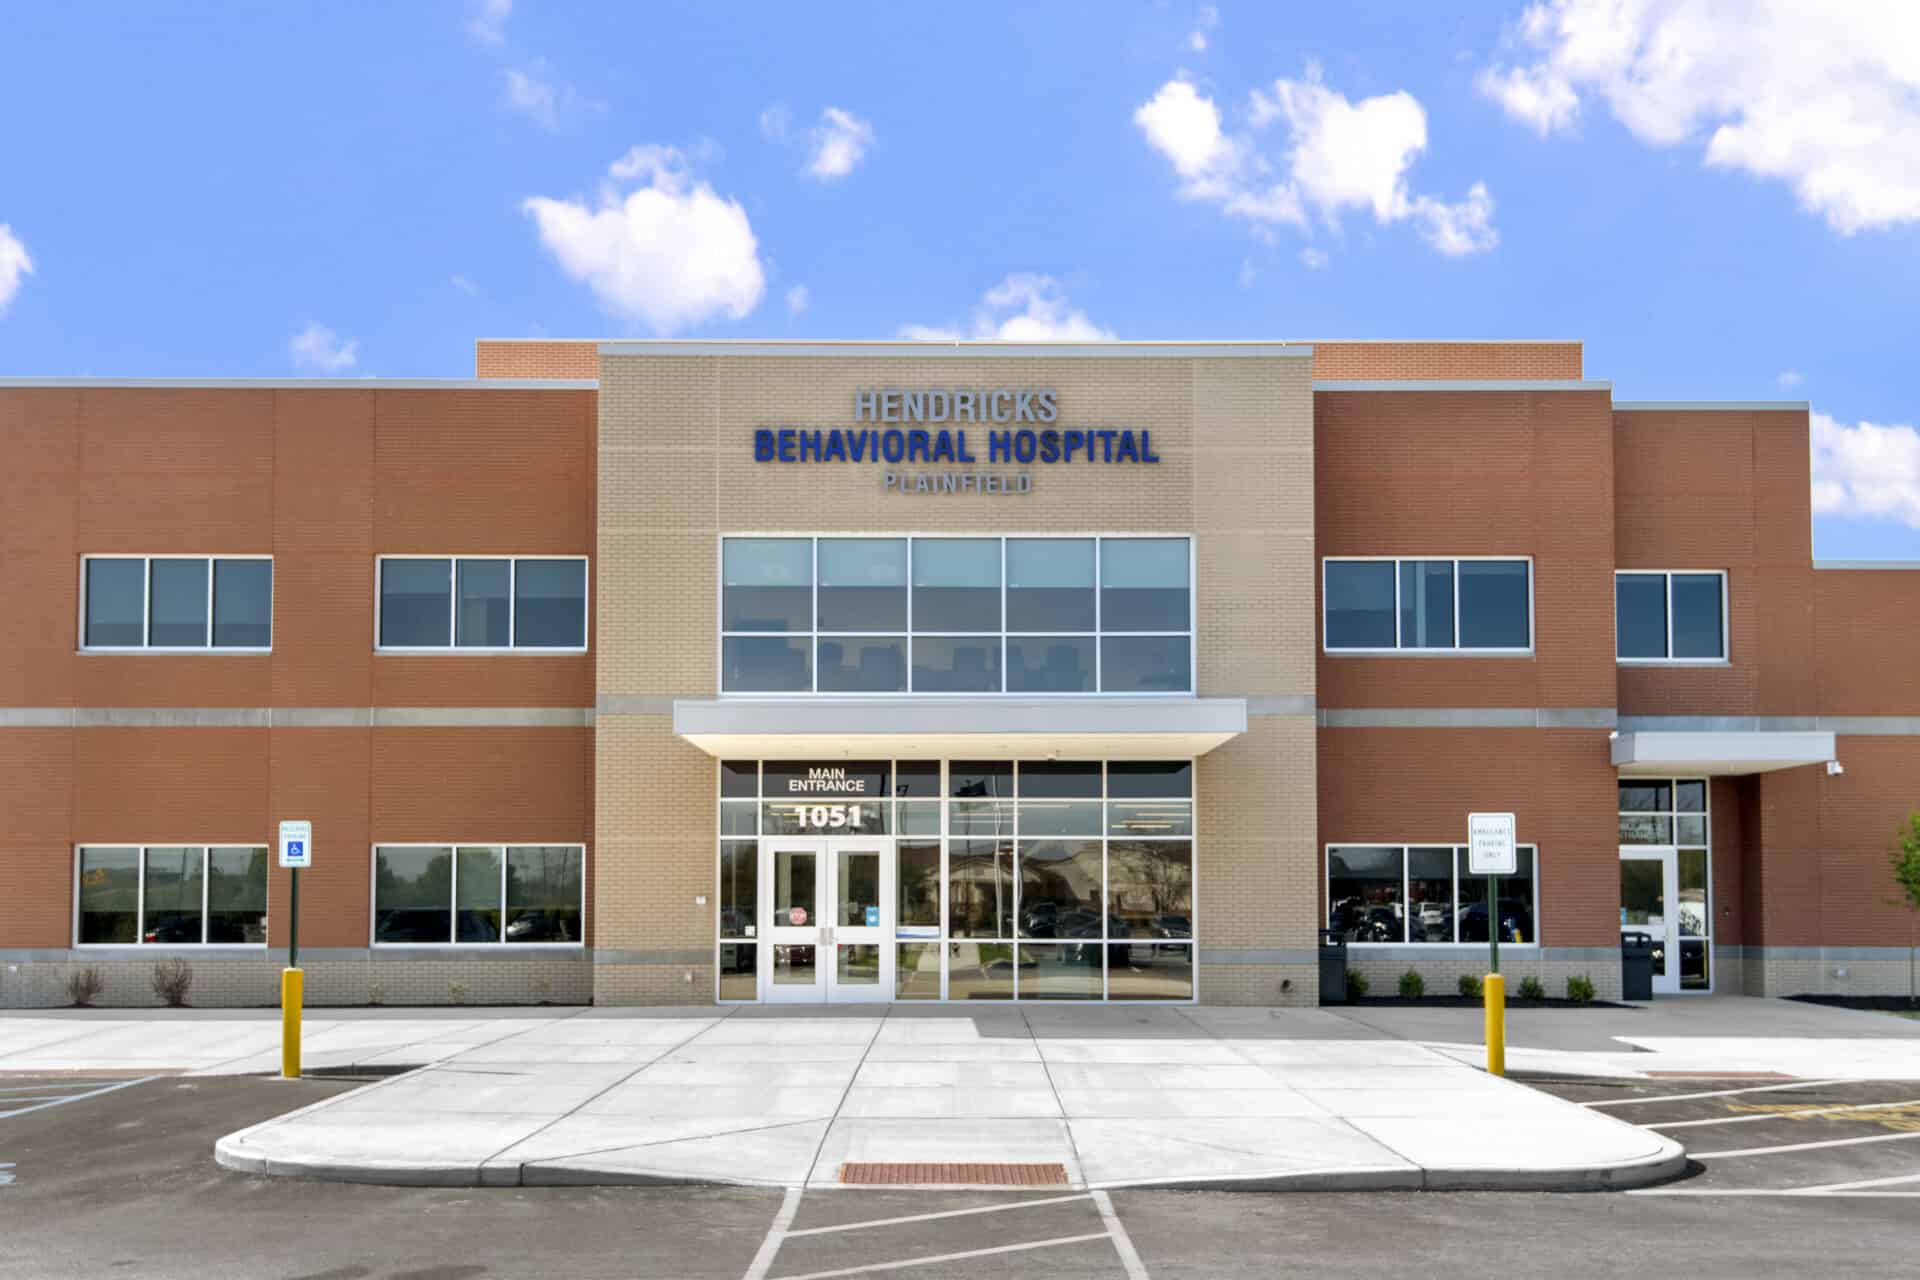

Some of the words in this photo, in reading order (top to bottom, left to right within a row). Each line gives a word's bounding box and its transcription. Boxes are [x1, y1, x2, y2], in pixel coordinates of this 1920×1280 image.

[856, 389, 1058, 423] HENDRICKS
[754, 430, 976, 463] BEHAVIORAL
[989, 430, 1160, 463] HOSPITAL
[884, 472, 1034, 495] PLAINFIELD
[808, 767, 846, 780] MAIN
[789, 780, 865, 792] ENTRANCE
[794, 804, 863, 828] 1051
